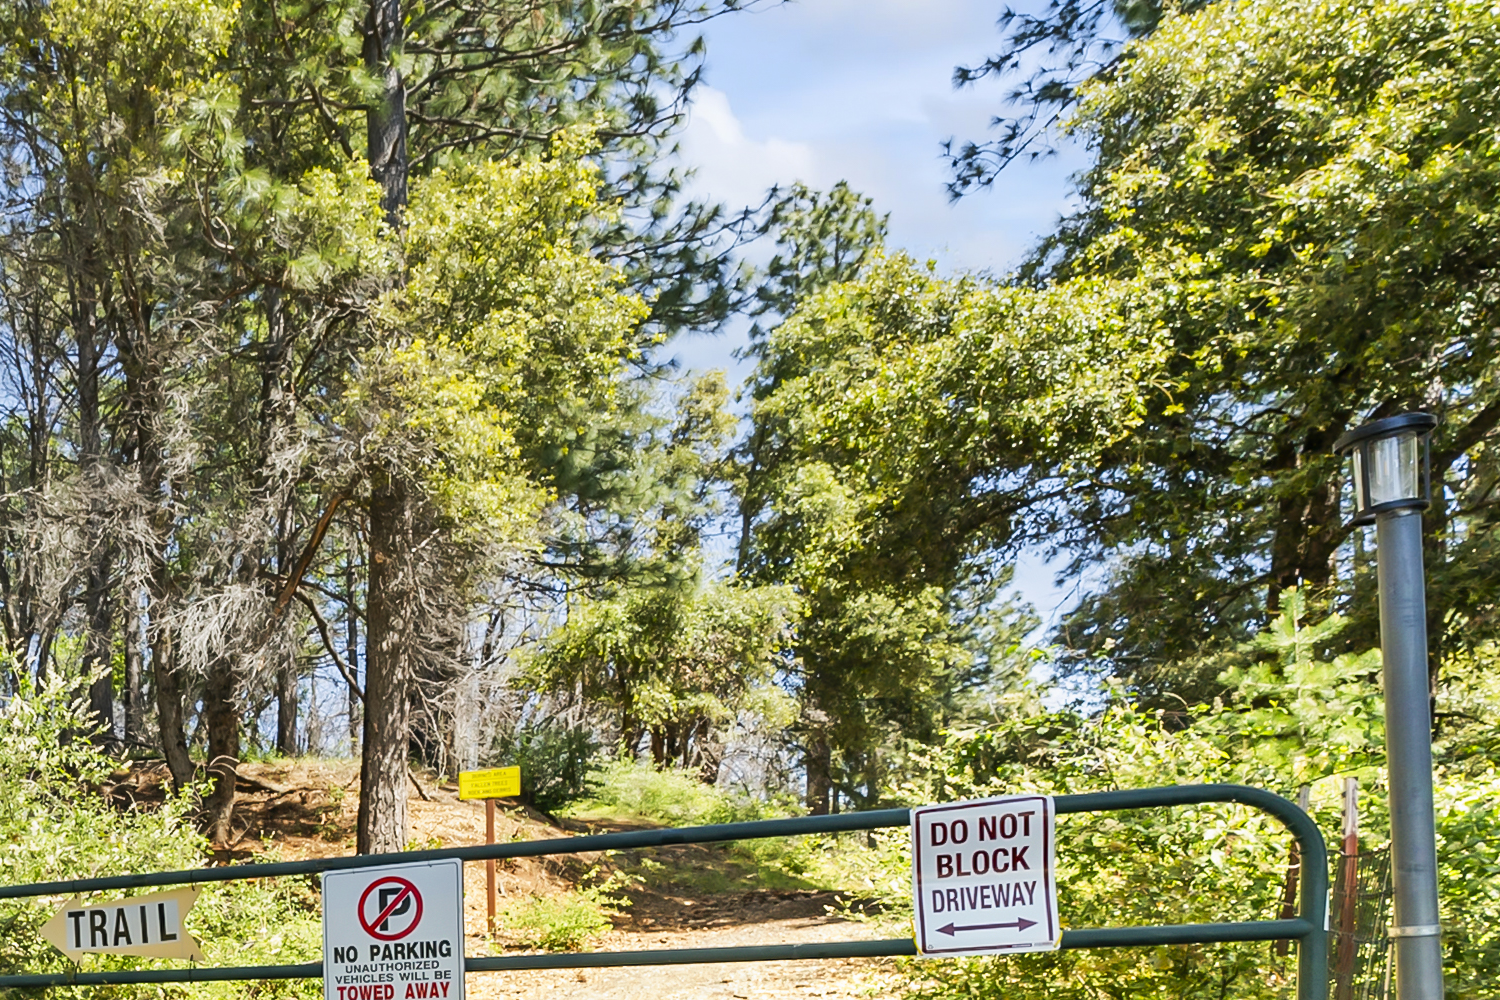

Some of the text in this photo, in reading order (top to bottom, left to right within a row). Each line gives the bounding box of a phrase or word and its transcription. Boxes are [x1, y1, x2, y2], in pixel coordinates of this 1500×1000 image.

[930, 811, 1036, 847] DO NOT
[936, 845, 1031, 879] BLOCK
[932, 880, 1037, 914] DRIVEWAY
[67, 903, 177, 948] TRAIL
[333, 940, 452, 964] NO PARKING
[334, 970, 452, 985] VEHICLES WILL BE
[345, 960, 440, 974] UNAUTHORIZED
[405, 981, 450, 999] AWAY
